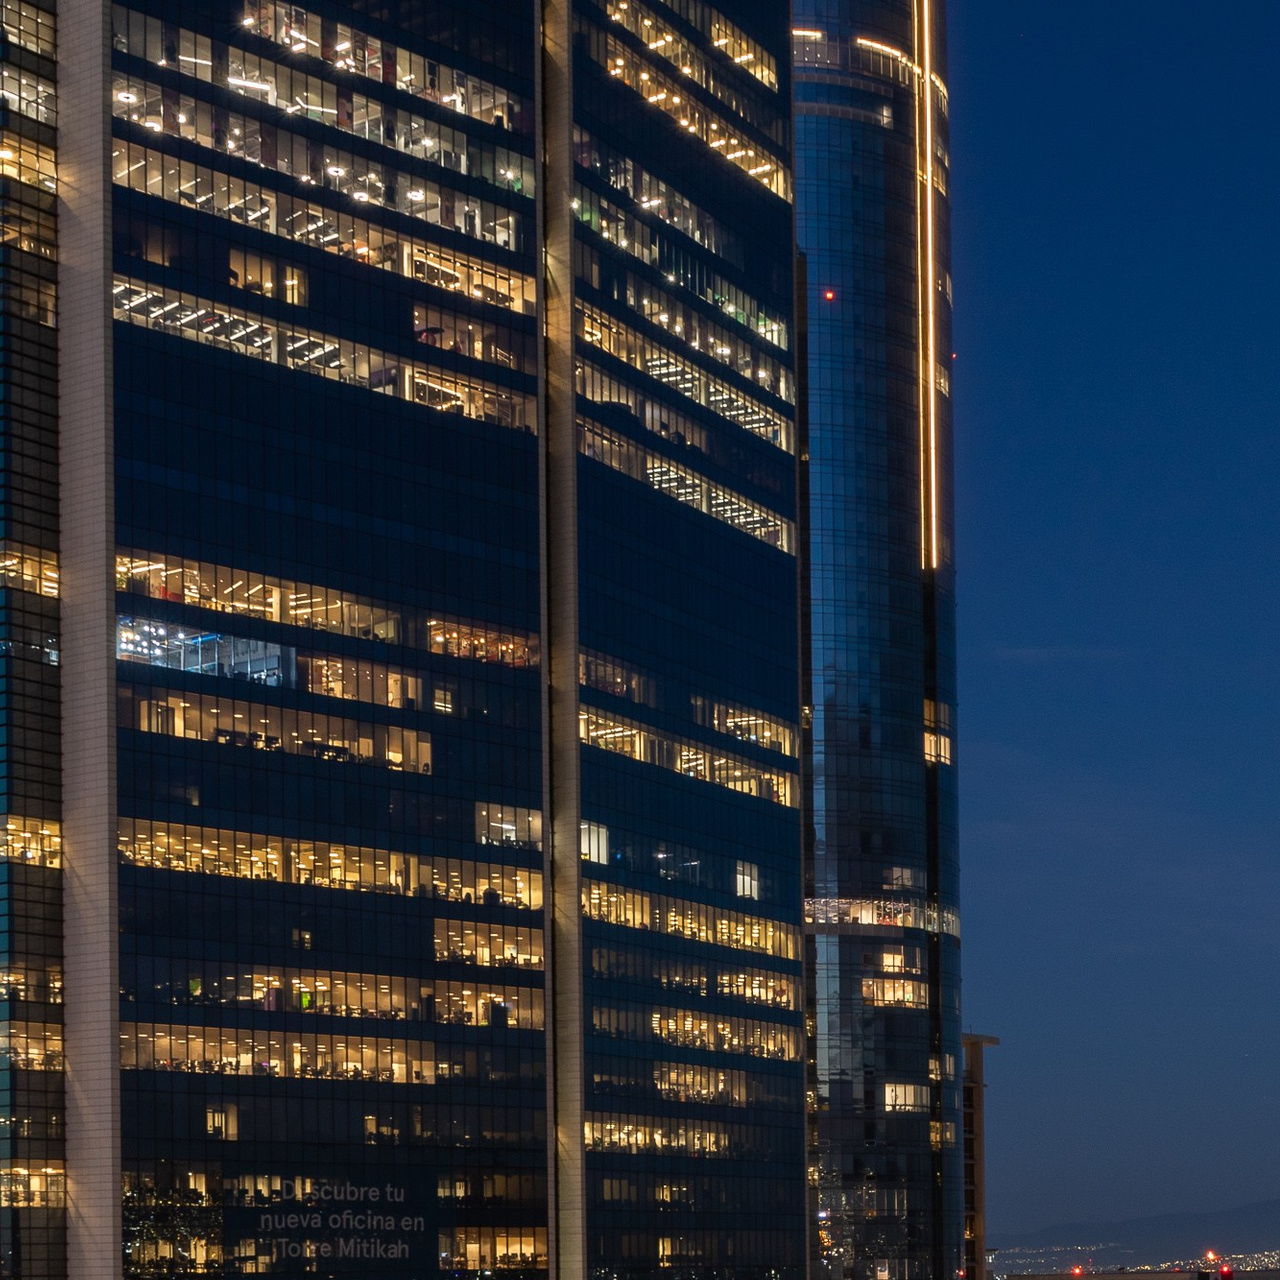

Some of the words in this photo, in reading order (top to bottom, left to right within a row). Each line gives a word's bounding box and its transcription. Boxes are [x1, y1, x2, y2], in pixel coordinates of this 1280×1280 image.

[385, 1183, 405, 1202] tu
[260, 1214, 322, 1230] nueva
[328, 1210, 395, 1231] oficina
[401, 1216, 425, 1232] en
[338, 1238, 410, 1259] Mitikah
